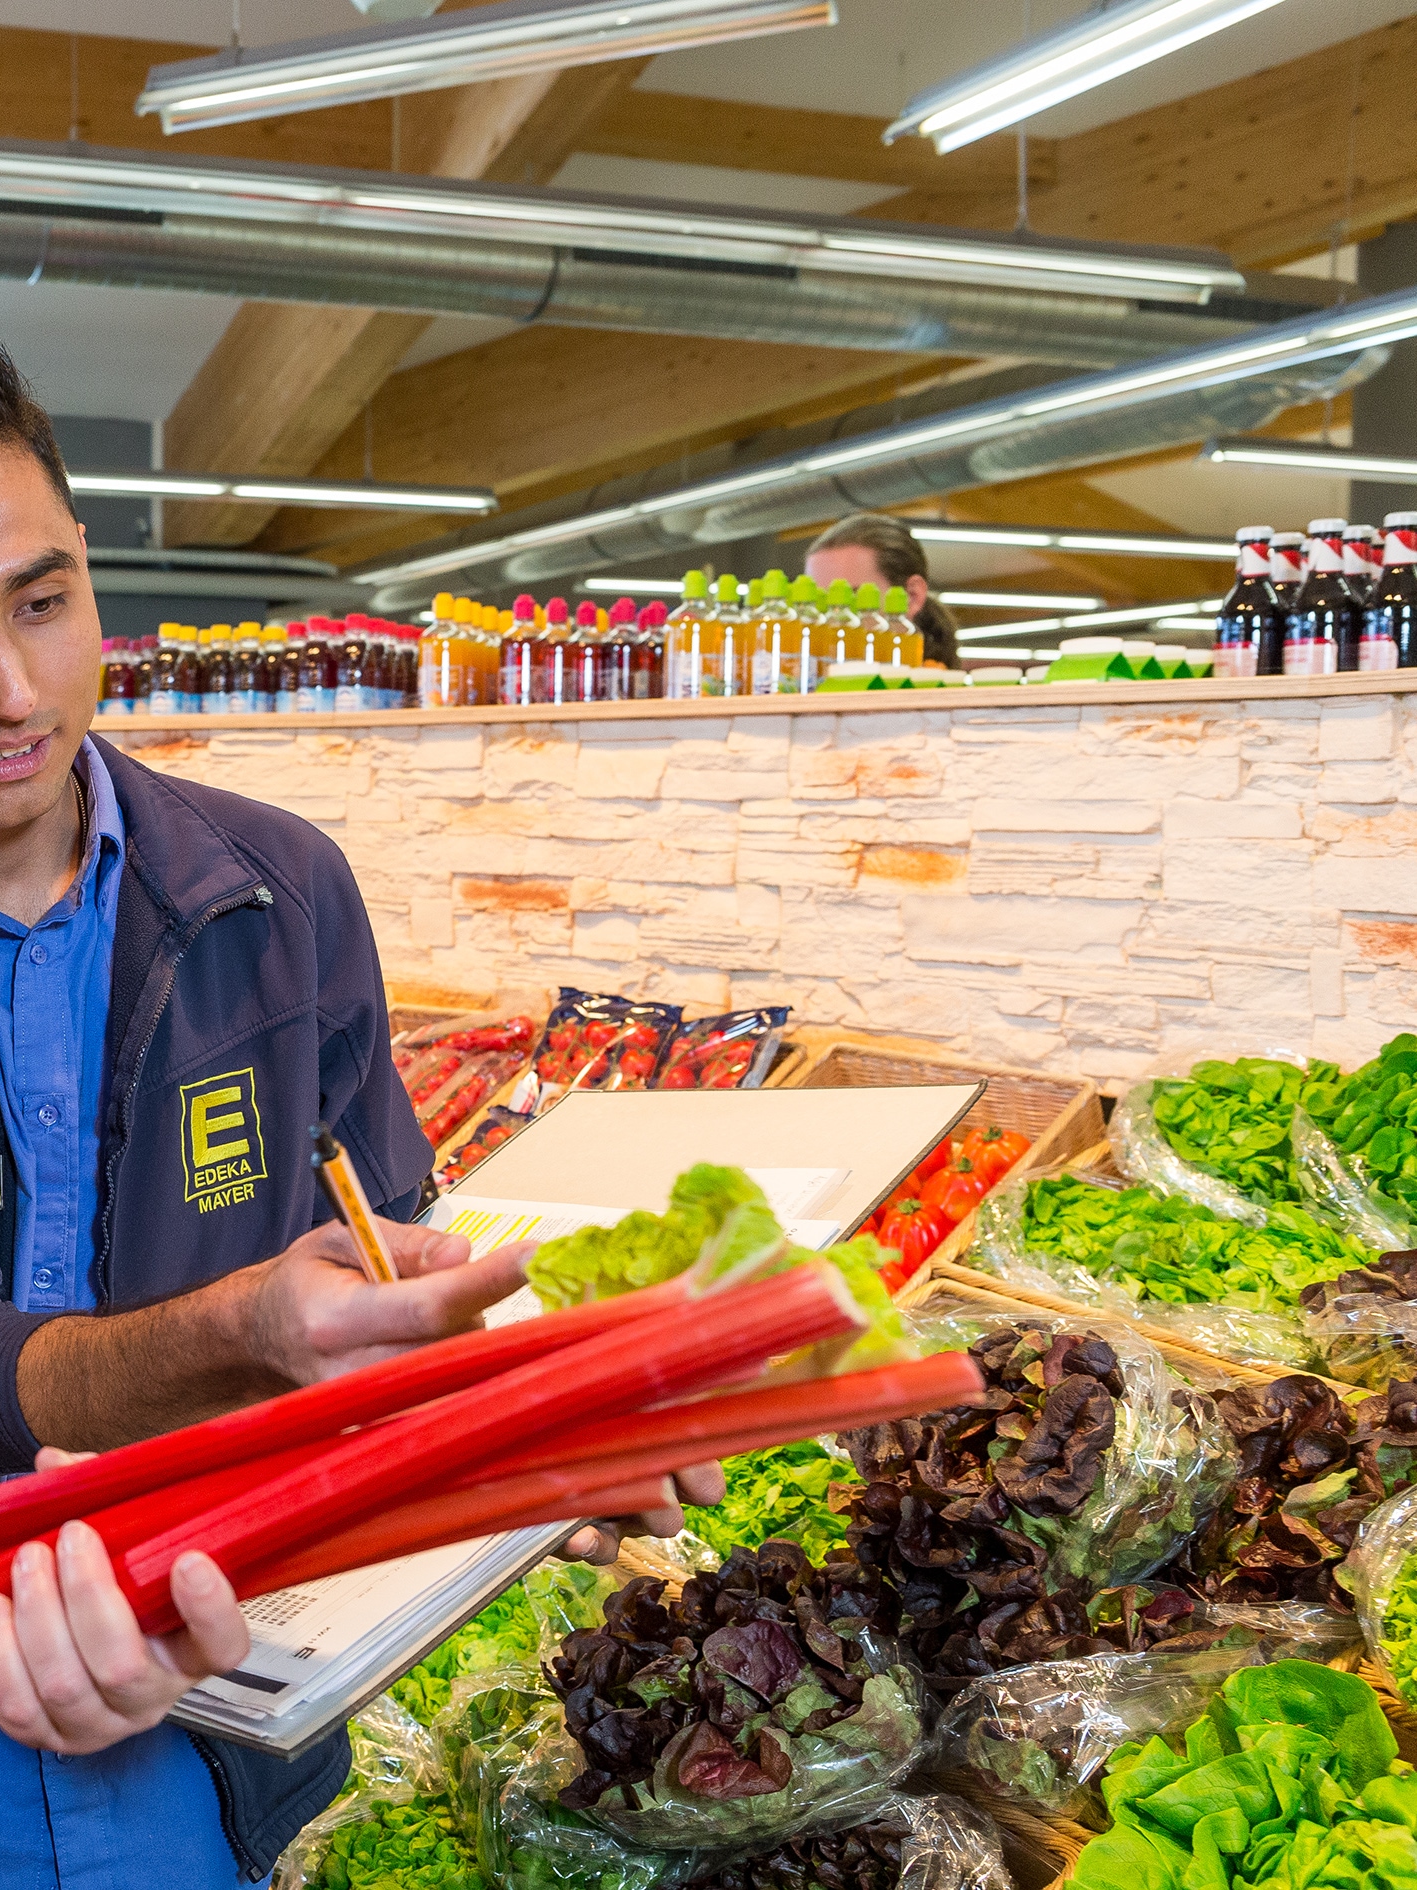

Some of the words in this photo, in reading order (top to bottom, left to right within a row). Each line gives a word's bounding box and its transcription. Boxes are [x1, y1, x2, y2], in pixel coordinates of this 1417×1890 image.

[191, 1086, 250, 1168] E
[194, 1158, 252, 1188] EDEKA
[198, 1183, 255, 1214] MAYER
